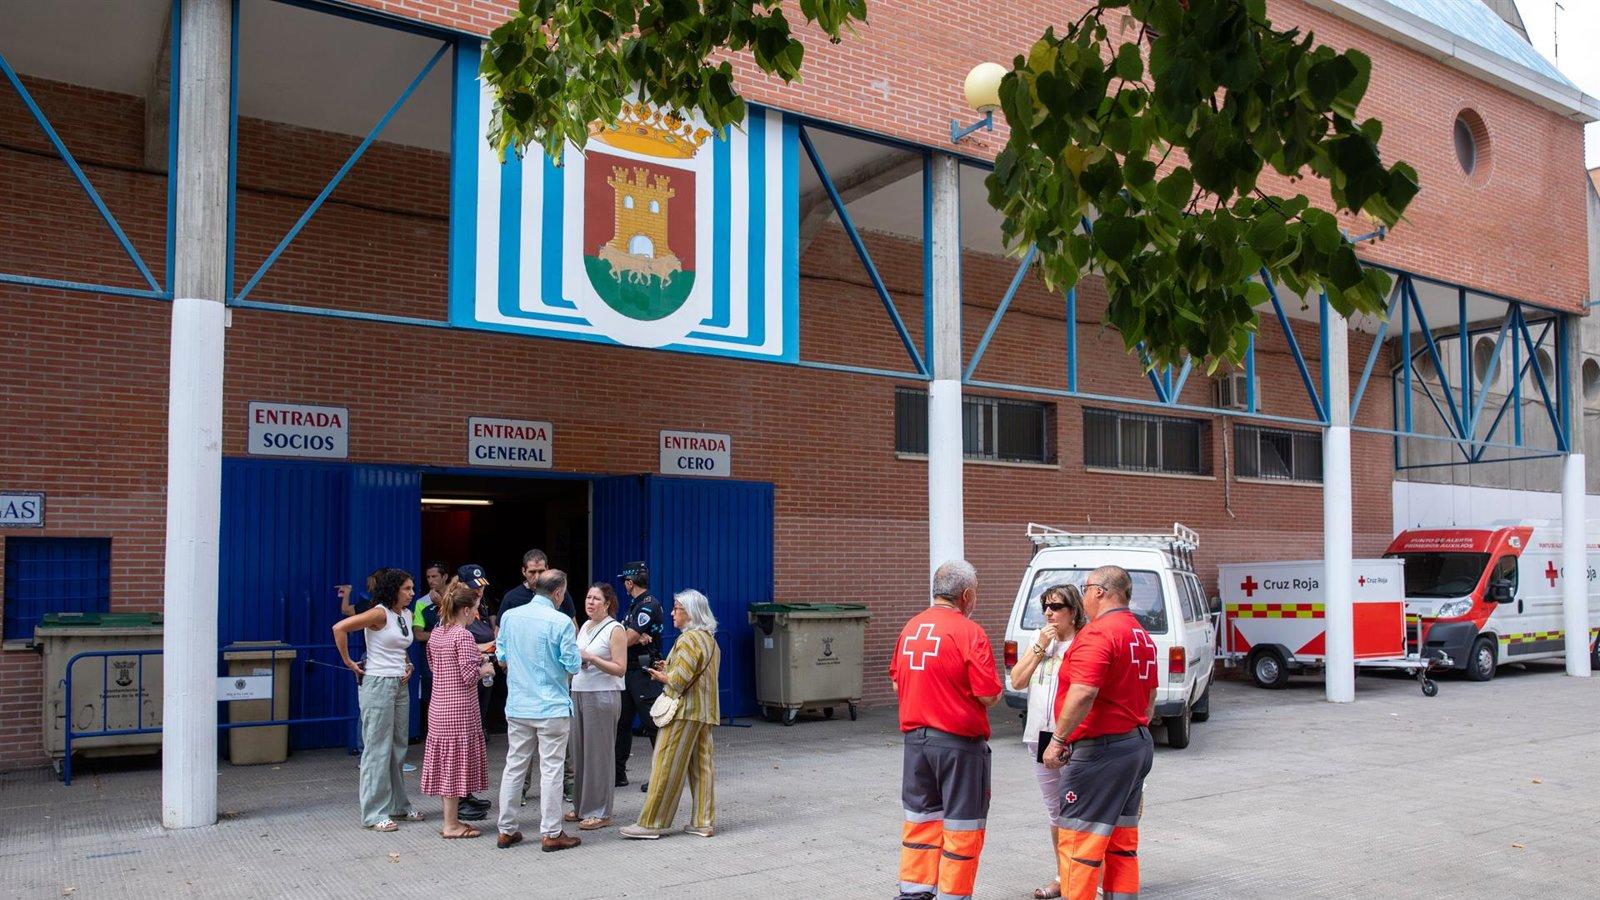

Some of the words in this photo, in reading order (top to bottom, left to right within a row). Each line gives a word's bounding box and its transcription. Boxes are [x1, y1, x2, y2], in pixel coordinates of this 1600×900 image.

[255, 409, 342, 428] ENTRADA
[474, 423, 547, 441] ENTRADA
[263, 432, 334, 451] SOCIOS
[664, 436, 726, 452] ENTRADA
[475, 445, 546, 462] GENERAL
[677, 456, 715, 471] CERO
[0, 500, 36, 519] AS
[1263, 579, 1290, 590] Cruz
[1292, 577, 1319, 592] Roja
